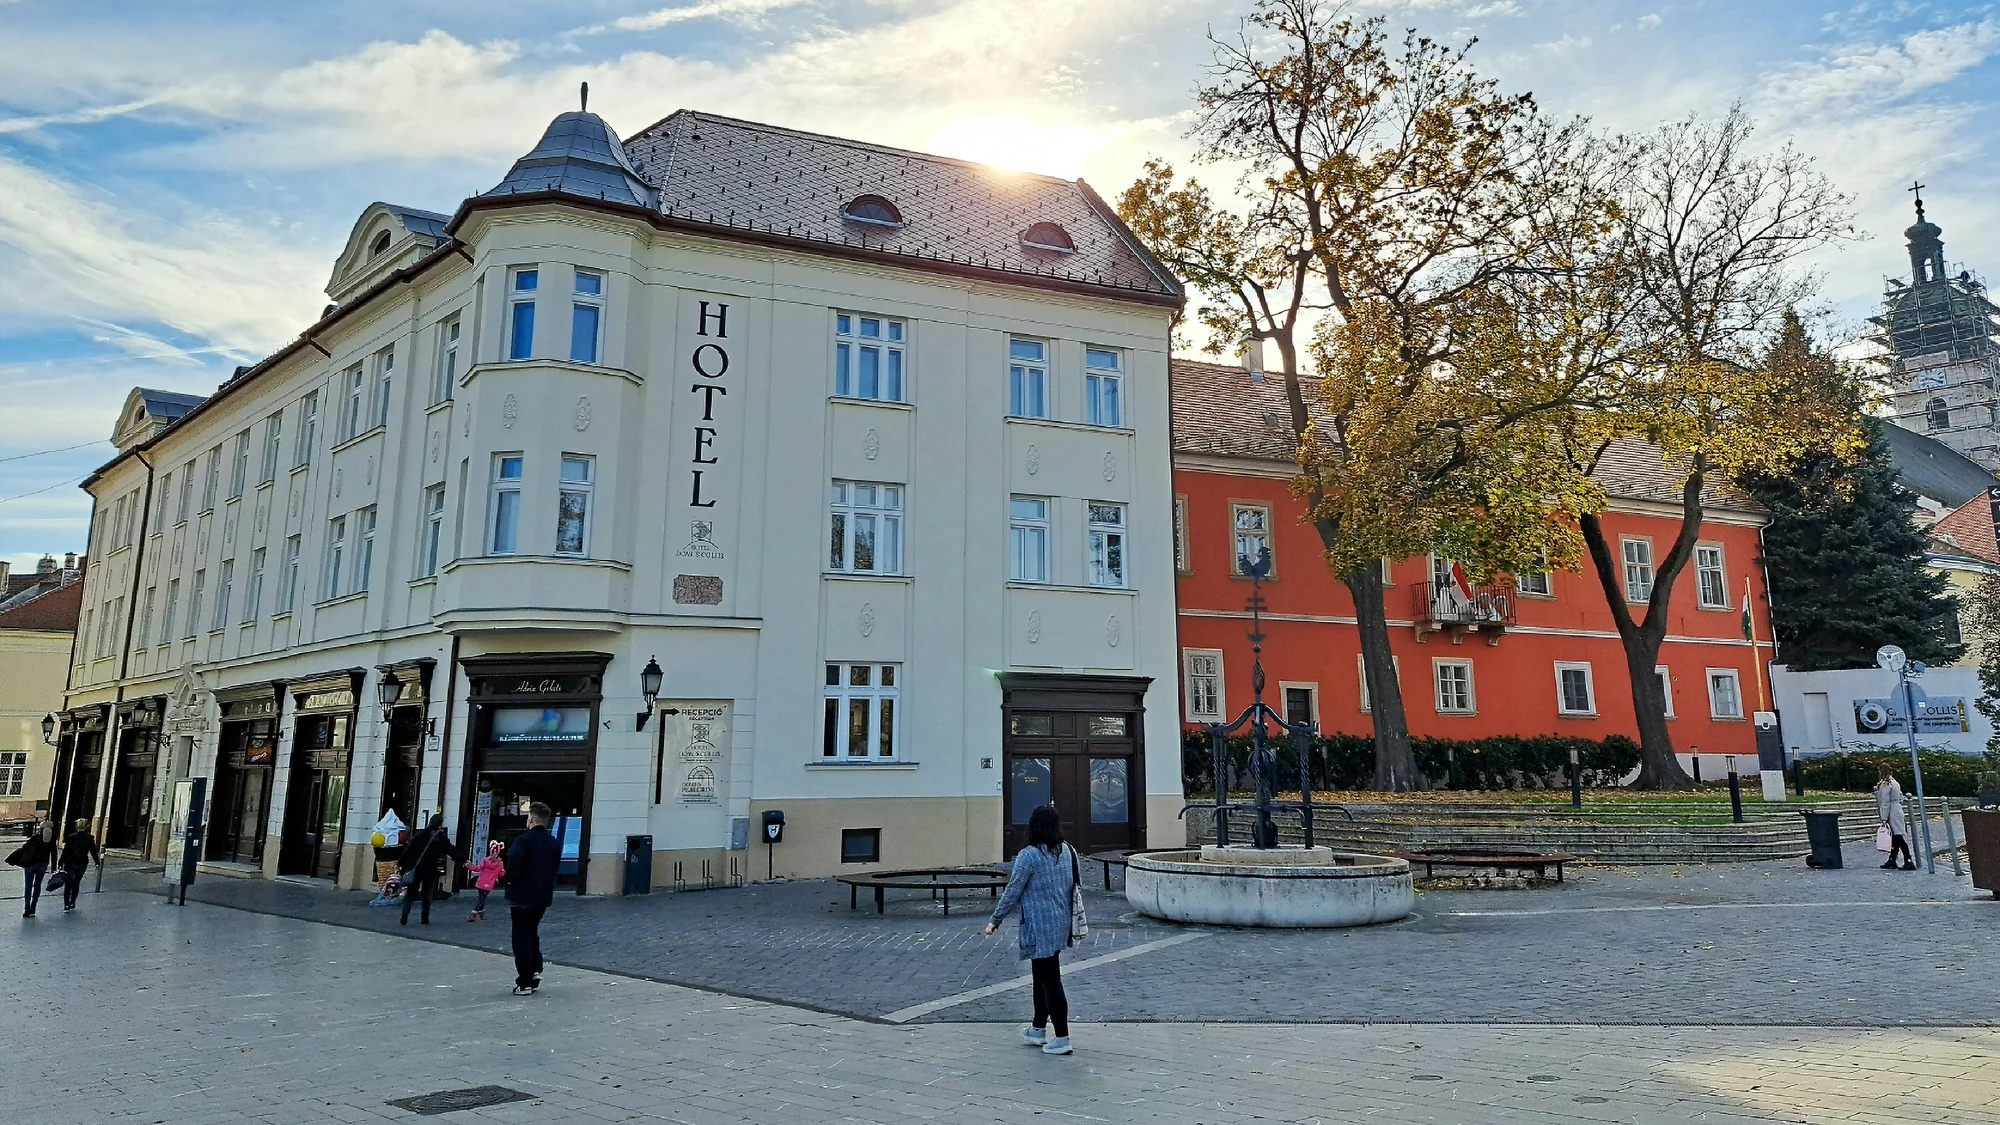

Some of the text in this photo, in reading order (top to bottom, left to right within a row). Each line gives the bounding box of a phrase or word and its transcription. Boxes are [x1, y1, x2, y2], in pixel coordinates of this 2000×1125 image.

[690, 301, 729, 508] HOTEL
[681, 708, 722, 716] RECEPCIÓ
[1923, 706, 1957, 716] OLLIS
